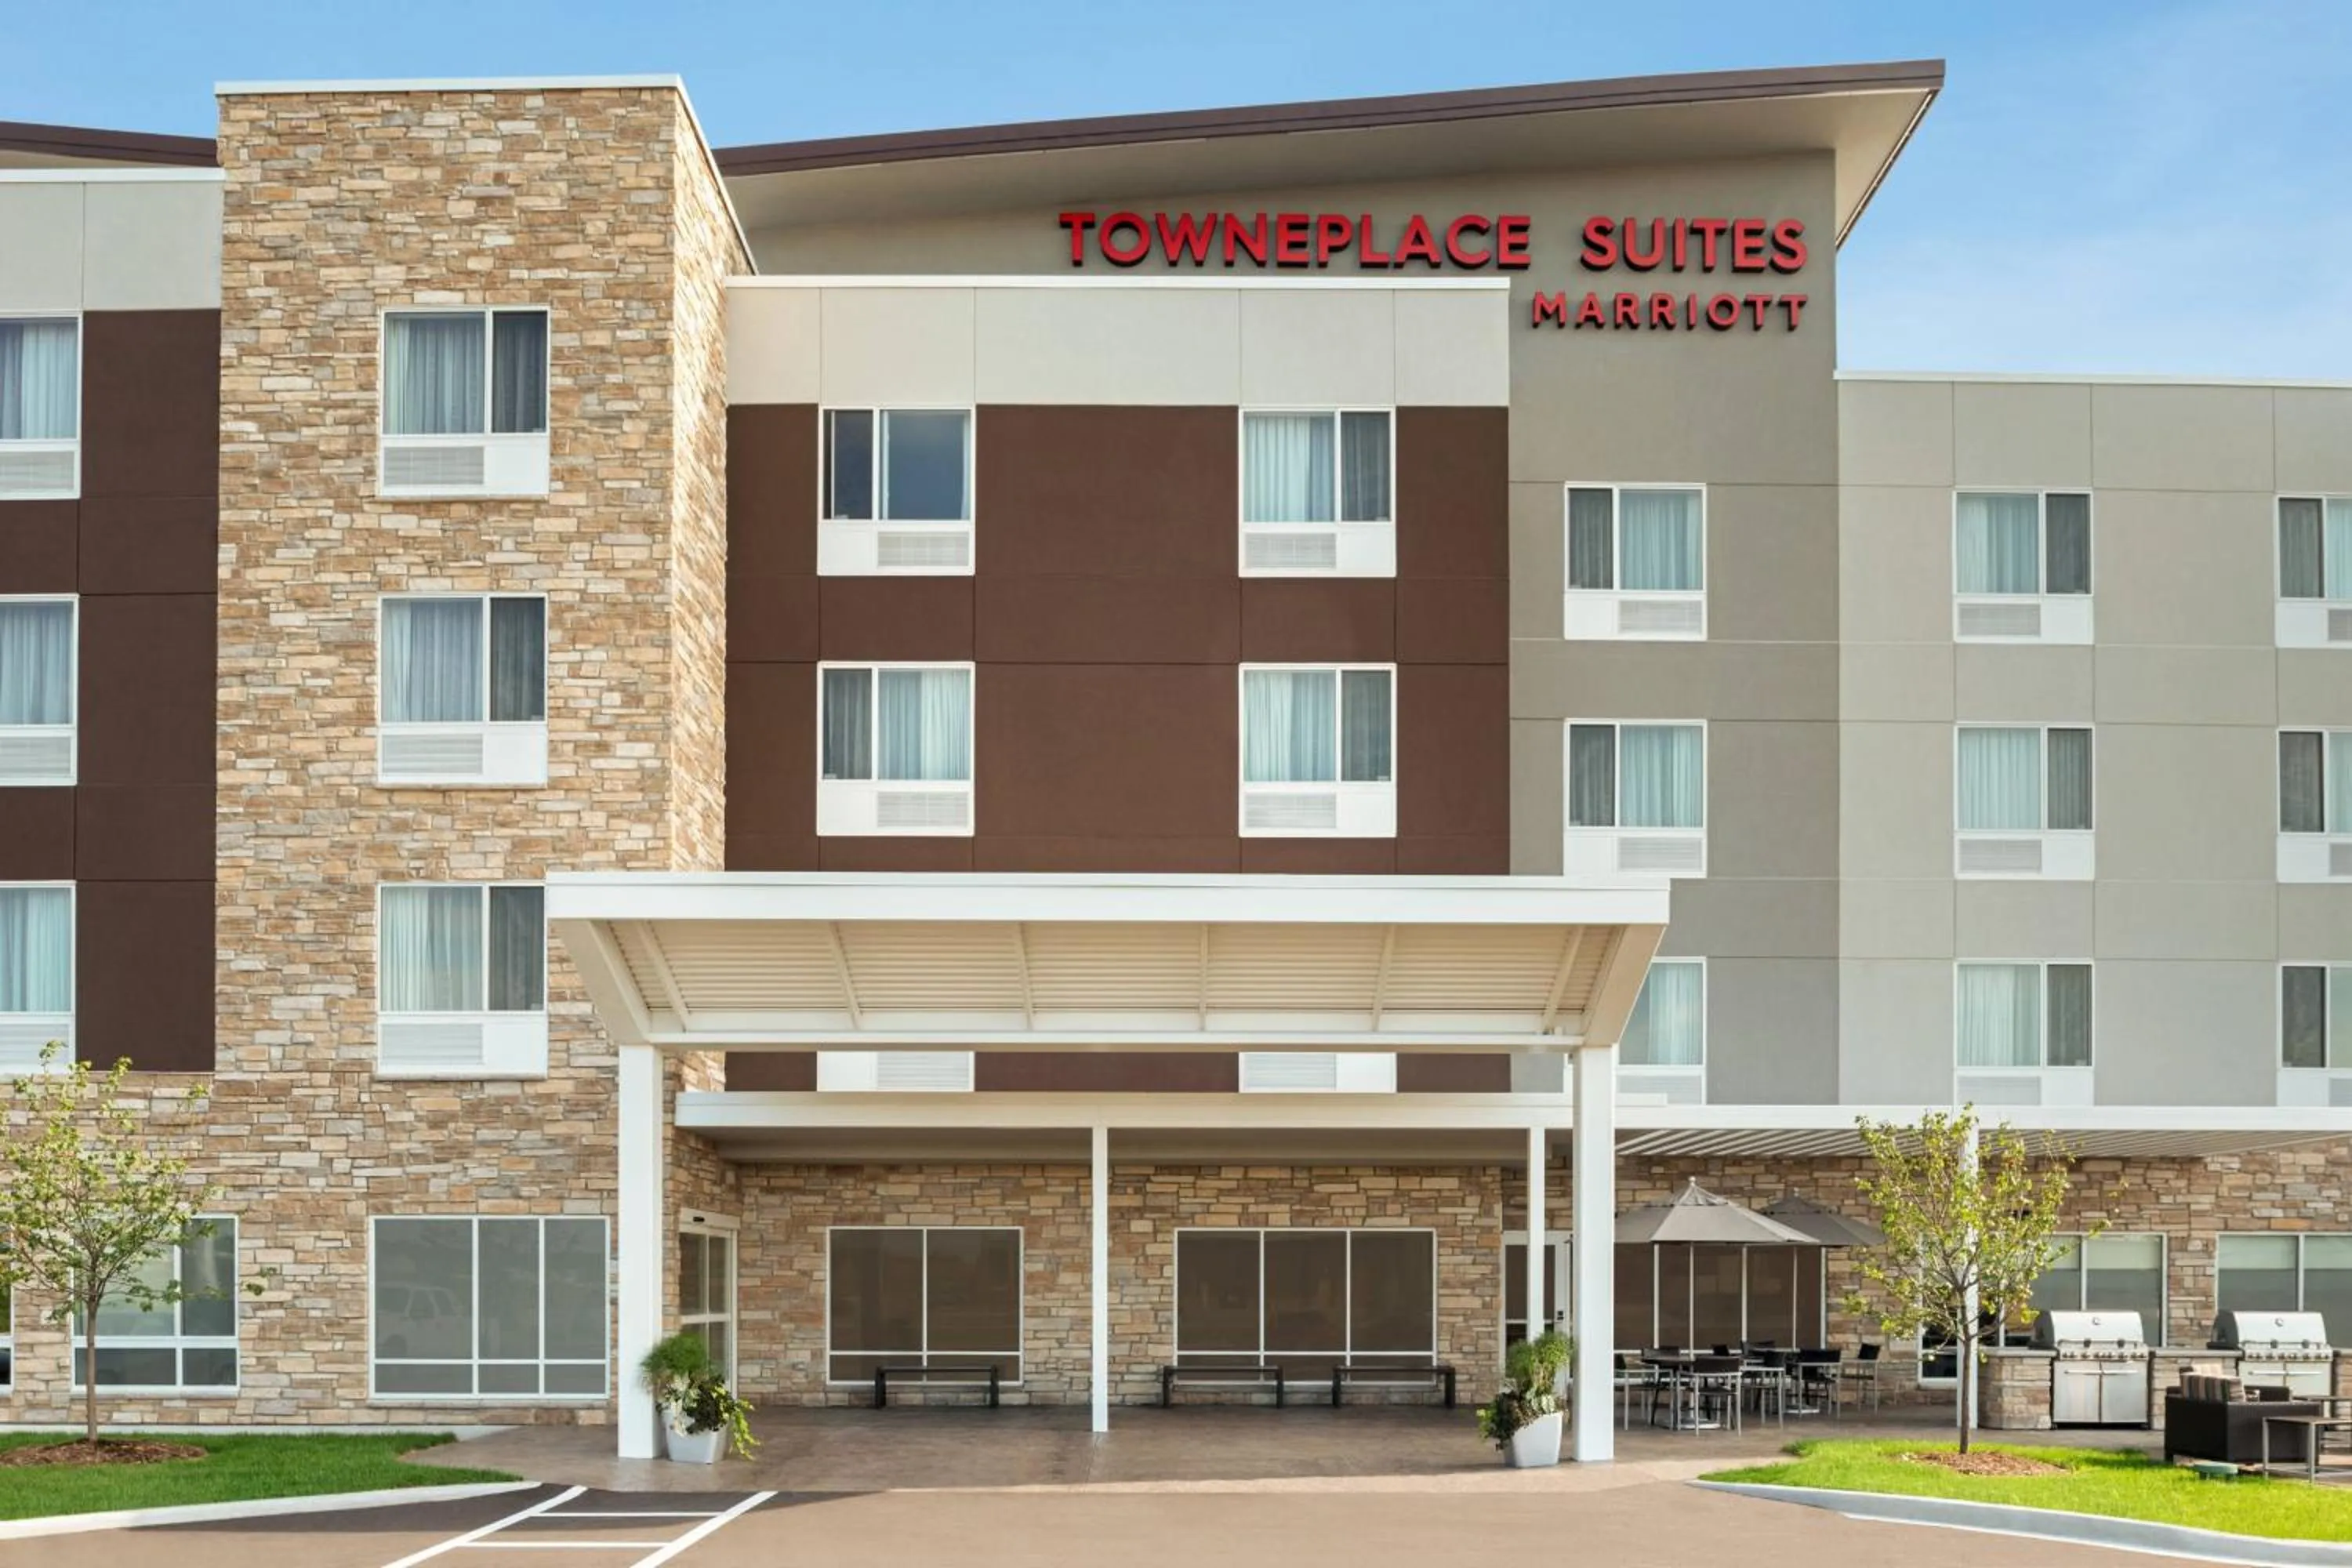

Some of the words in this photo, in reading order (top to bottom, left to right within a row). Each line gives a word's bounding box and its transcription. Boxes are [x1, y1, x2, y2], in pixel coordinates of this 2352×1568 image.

[1059, 211, 1532, 267] TOWNEPLACE
[1581, 216, 1809, 270] SUITES
[1533, 292, 1809, 329] MARRIOTT
